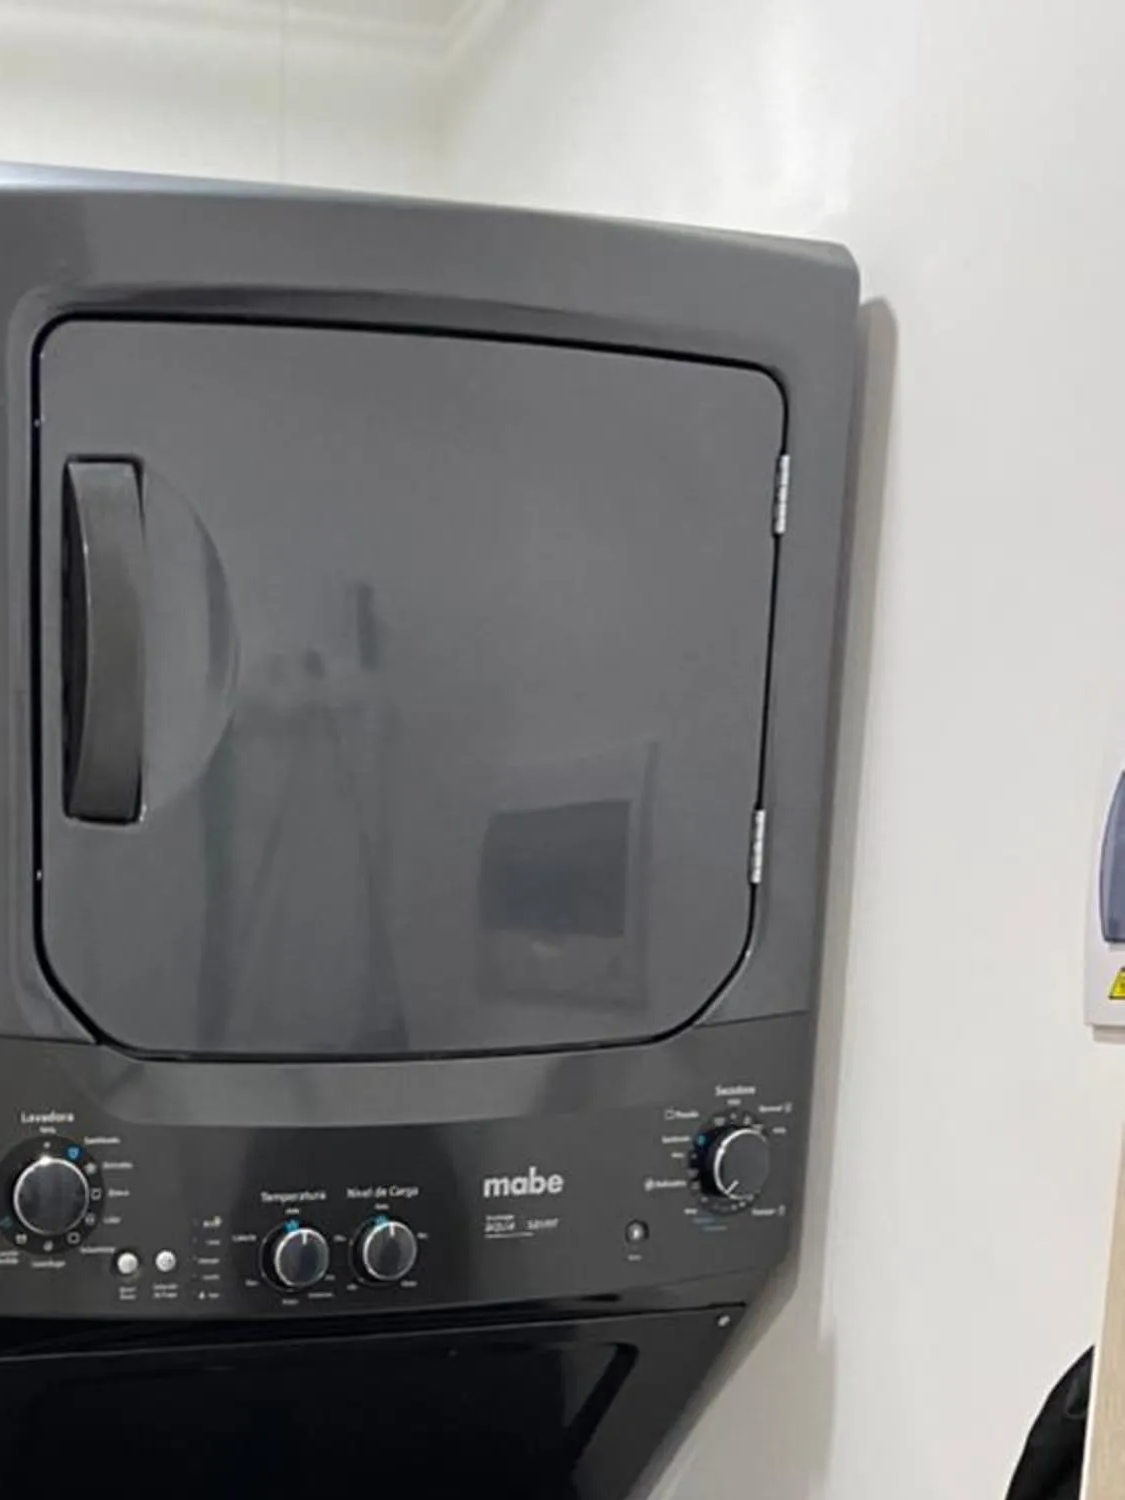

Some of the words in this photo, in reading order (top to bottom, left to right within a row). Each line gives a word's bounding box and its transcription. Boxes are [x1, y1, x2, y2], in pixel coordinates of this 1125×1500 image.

[20, 1110, 75, 1124] Lavadora
[483, 1165, 564, 1198] mabe
[260, 1191, 326, 1206] Temperatura
[347, 1187, 373, 1198] Nivel
[389, 1185, 419, 1199] Carga
